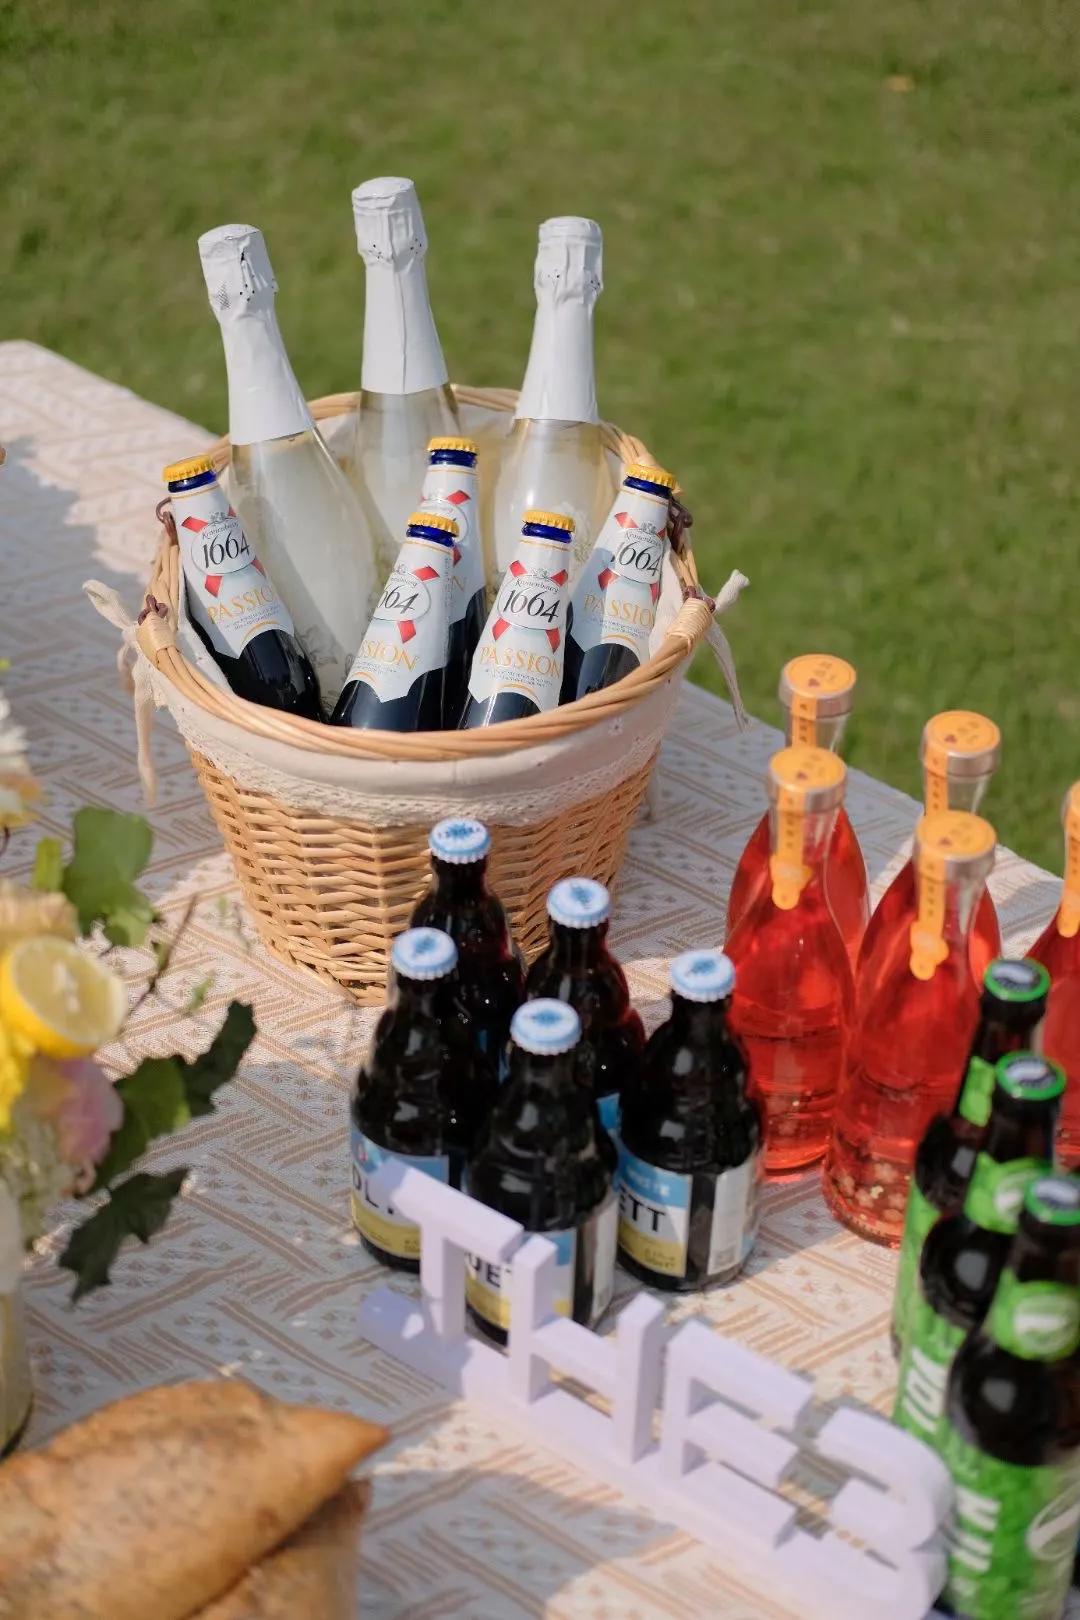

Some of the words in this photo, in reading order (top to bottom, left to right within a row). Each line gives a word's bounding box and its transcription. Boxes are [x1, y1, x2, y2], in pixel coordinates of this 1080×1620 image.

[203, 530, 250, 568] 1664
[611, 541, 661, 576] 1664
[208, 586, 273, 624] PASSIO
[378, 584, 420, 614] 64
[503, 587, 561, 623] 1664
[584, 593, 656, 627] PASSIO
[480, 646, 561, 680] PASSION
